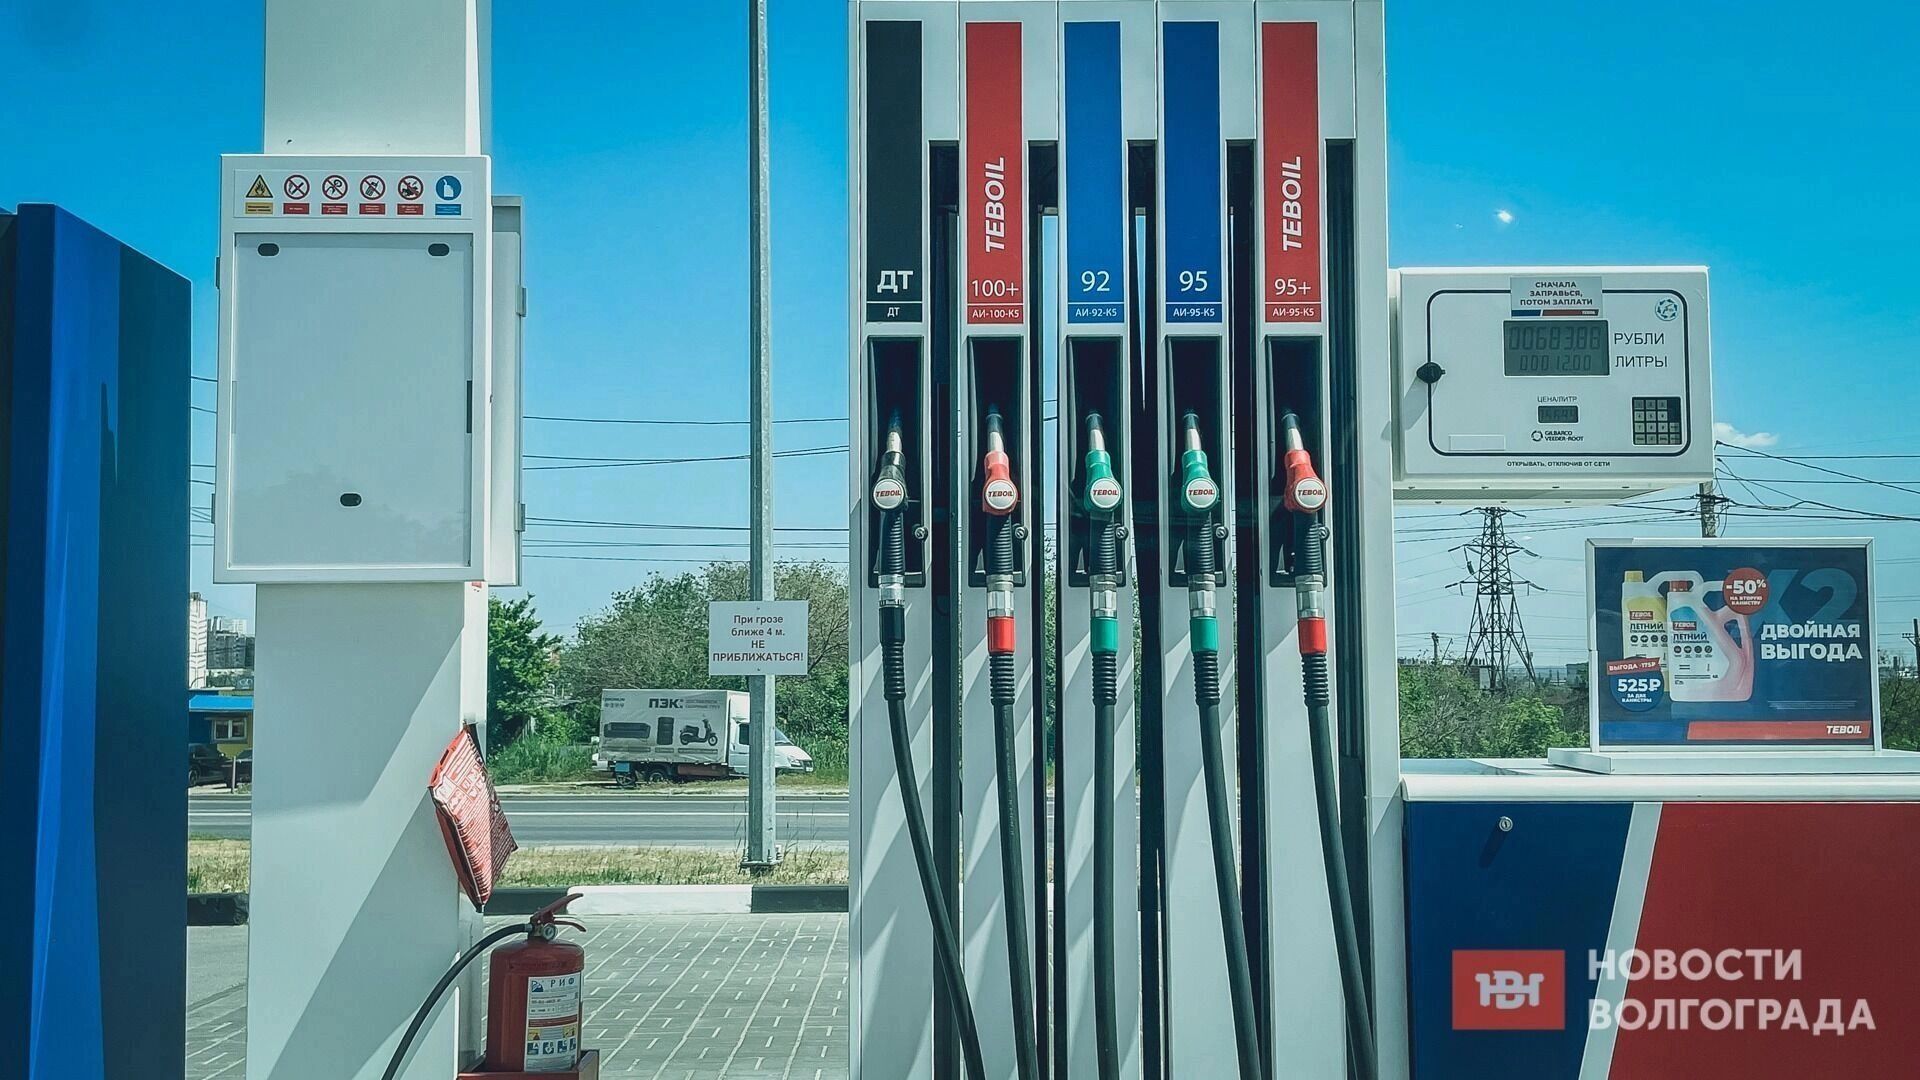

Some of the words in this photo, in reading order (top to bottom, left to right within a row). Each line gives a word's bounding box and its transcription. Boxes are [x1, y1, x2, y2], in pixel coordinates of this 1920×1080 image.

[984, 156, 1006, 253] TEBOIL
[1281, 155, 1303, 252] TEBOIL
[877, 270, 914, 294] ДТ
[1080, 270, 1111, 293] 92
[1179, 270, 1208, 293] 95
[1274, 278, 1312, 296] 95+
[971, 279, 1020, 297] 100+
[1530, 290, 1583, 298] ЗАПРАВЬСЯ,
[1520, 298, 1551, 306] ПОТОМ
[1552, 298, 1593, 306] ЗАПЛАТИ
[887, 307, 900, 318] ДТ
[972, 308, 1020, 319] АИ-100-К5
[1075, 307, 1118, 318] АИ-92-К5
[1173, 307, 1215, 318] АИ-95-К5
[1272, 307, 1315, 318] АИ-95-К5
[1614, 332, 1665, 346] РУБЛИ
[1615, 355, 1668, 369] ЛИТРЫ
[875, 489, 902, 498] TEBOIL
[987, 490, 1014, 498] TEBOIL
[1092, 488, 1119, 497] TEBOIL
[1188, 488, 1216, 497] TEBOIL
[1297, 488, 1324, 497] TEBOIL
[1726, 579, 1767, 595] -50%
[733, 615, 753, 625] При
[756, 616, 784, 625] грозе
[1630, 621, 1664, 630] ЛЕТНИЙ
[731, 628, 764, 637] ближе
[766, 628, 773, 636] 4
[1673, 631, 1708, 640] ЛЕТНИЙ
[1761, 620, 1861, 641] ДВОЙНАЯ
[751, 640, 766, 649] НЕ
[712, 652, 805, 662] ПРИБЛИЖАТЬСЯ!
[1761, 643, 1863, 662] ВЫГОДА
[1609, 663, 1639, 671] ВЫГОДА
[1826, 724, 1863, 735] TEBOIL
